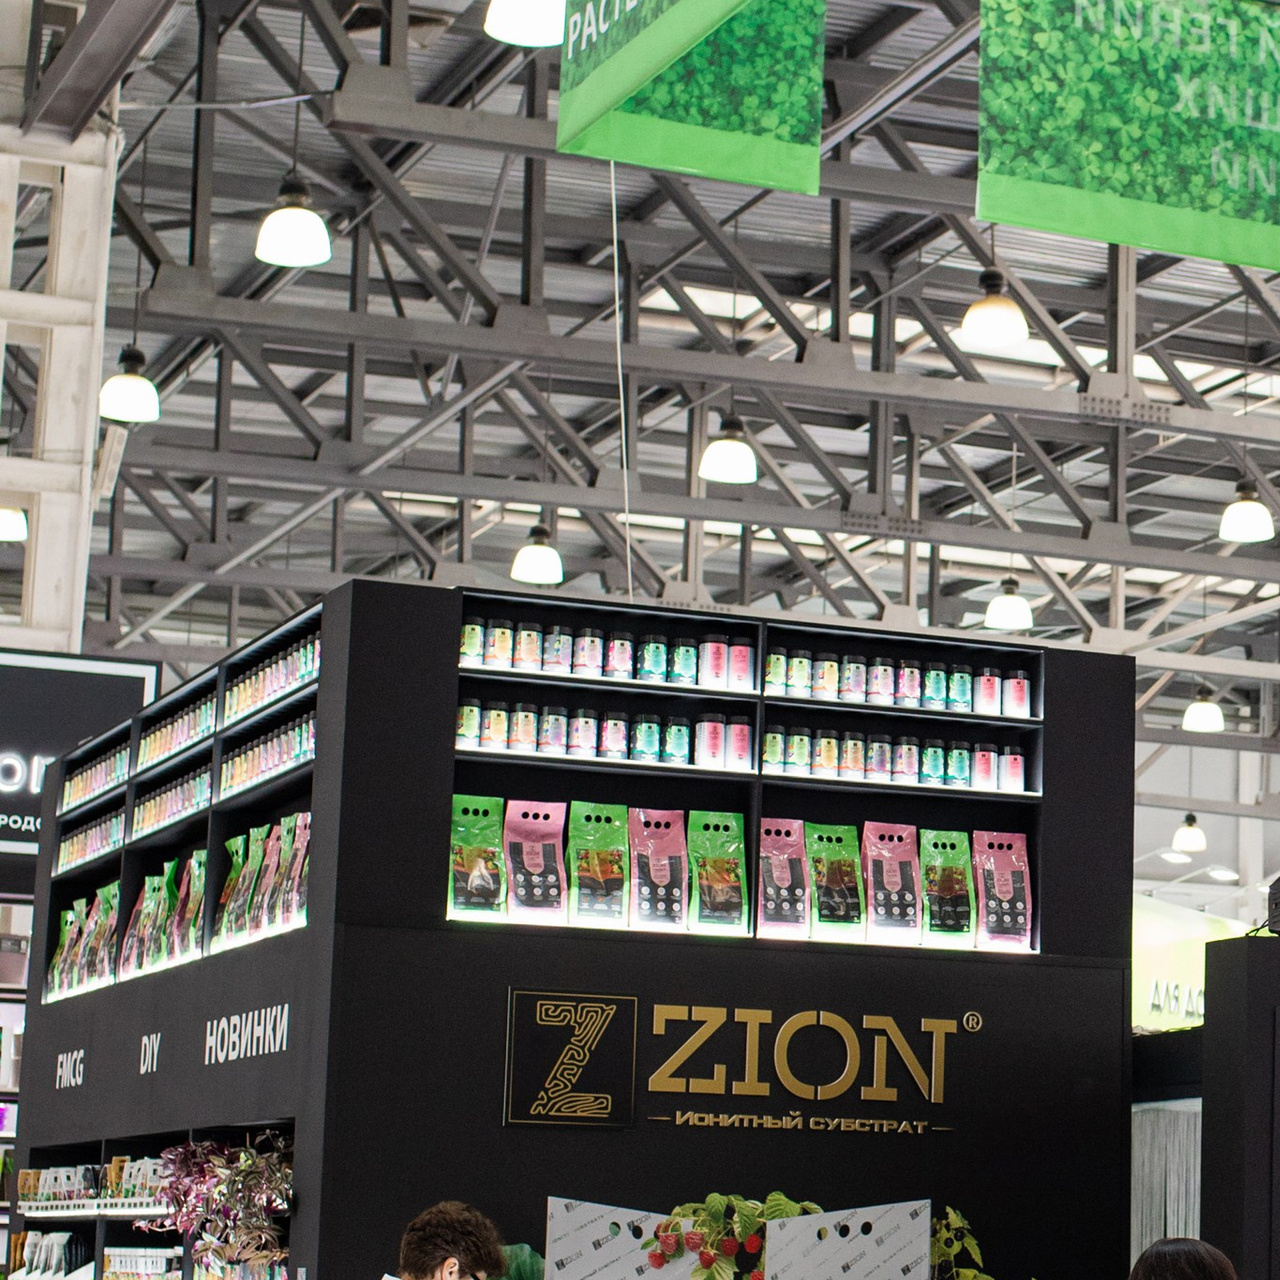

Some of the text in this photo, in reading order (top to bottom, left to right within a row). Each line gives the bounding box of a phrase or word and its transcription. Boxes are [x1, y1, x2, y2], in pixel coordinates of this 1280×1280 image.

[140, 1033, 161, 1075] DIY
[205, 1003, 290, 1065] НОВИНКИ
[56, 1048, 84, 1089] FMCG
[675, 1110, 929, 1135] ИОНИТНЫЙ СУБСТРАТ
